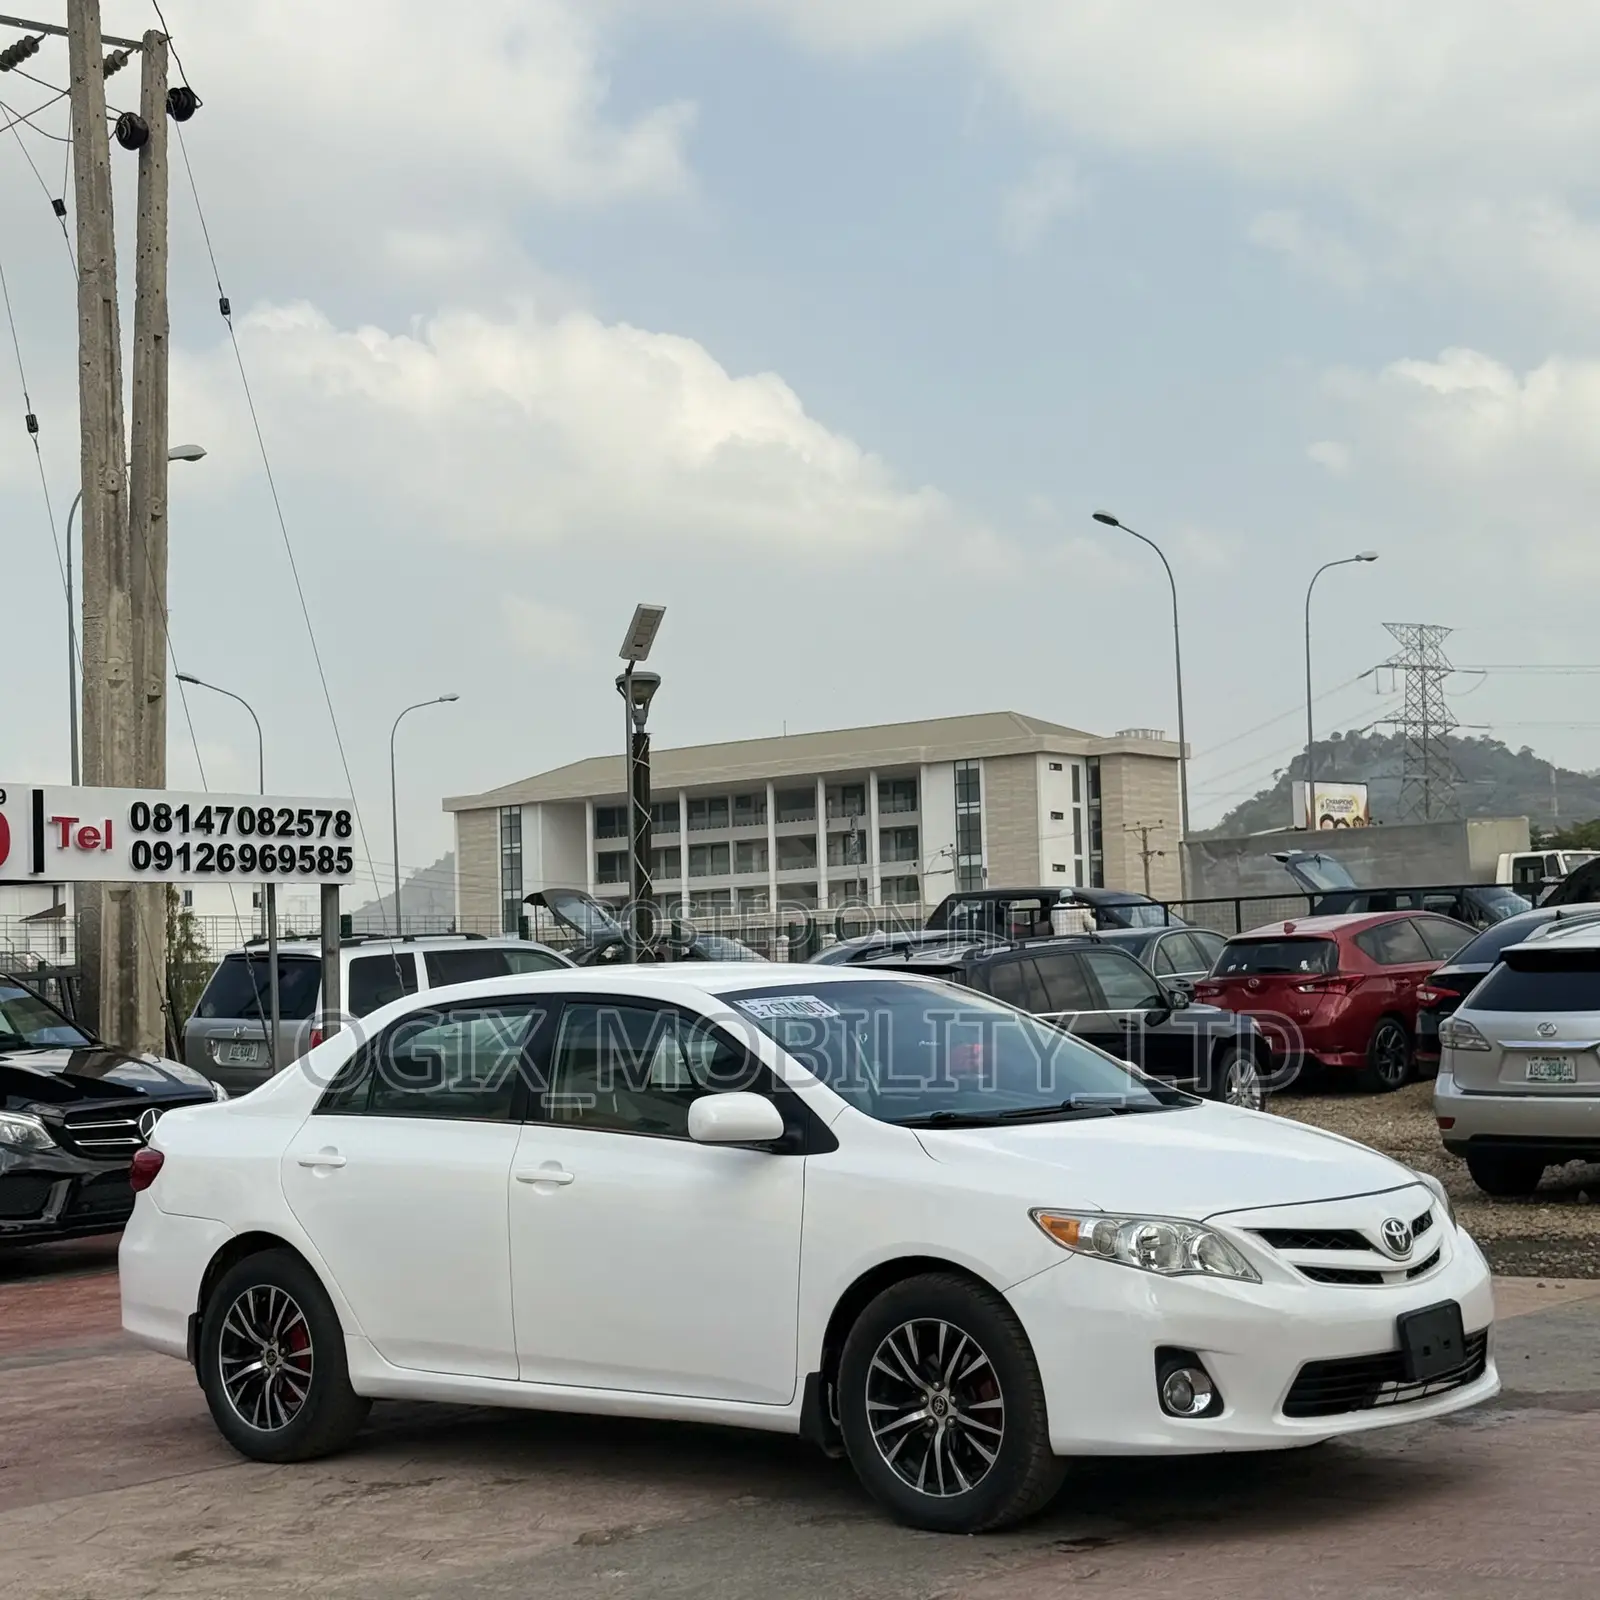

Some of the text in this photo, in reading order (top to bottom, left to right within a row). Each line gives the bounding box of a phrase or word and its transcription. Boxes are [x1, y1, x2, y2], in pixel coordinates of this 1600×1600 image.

[51, 815, 113, 850] Tel
[130, 801, 352, 838] 08147082578
[131, 840, 353, 874] 09126969585
